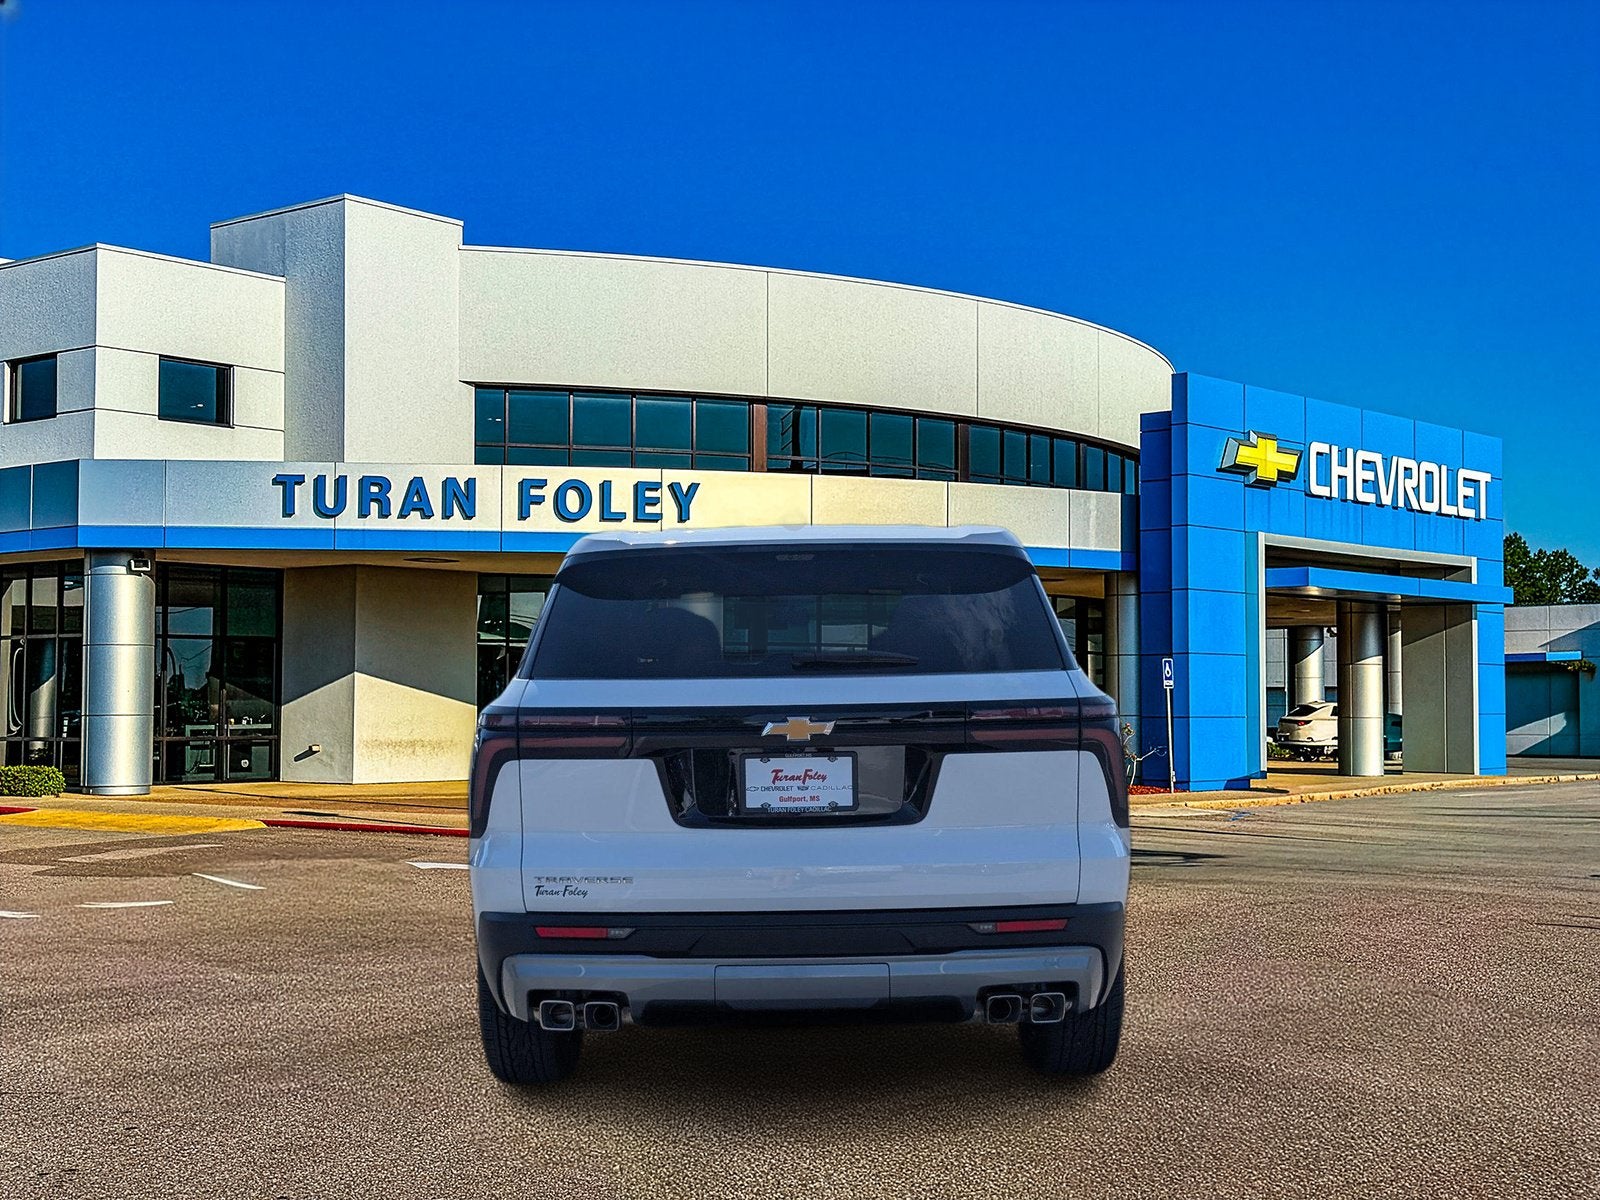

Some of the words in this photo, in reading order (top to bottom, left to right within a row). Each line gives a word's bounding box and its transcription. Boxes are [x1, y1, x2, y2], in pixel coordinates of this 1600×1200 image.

[1307, 441, 1492, 521] CHEVROLET
[272, 474, 477, 520] TURAN
[518, 478, 701, 524] FOLEY
[770, 768, 802, 785] Turan
[802, 768, 828, 785] Foley
[534, 876, 634, 884] TRAVERSE
